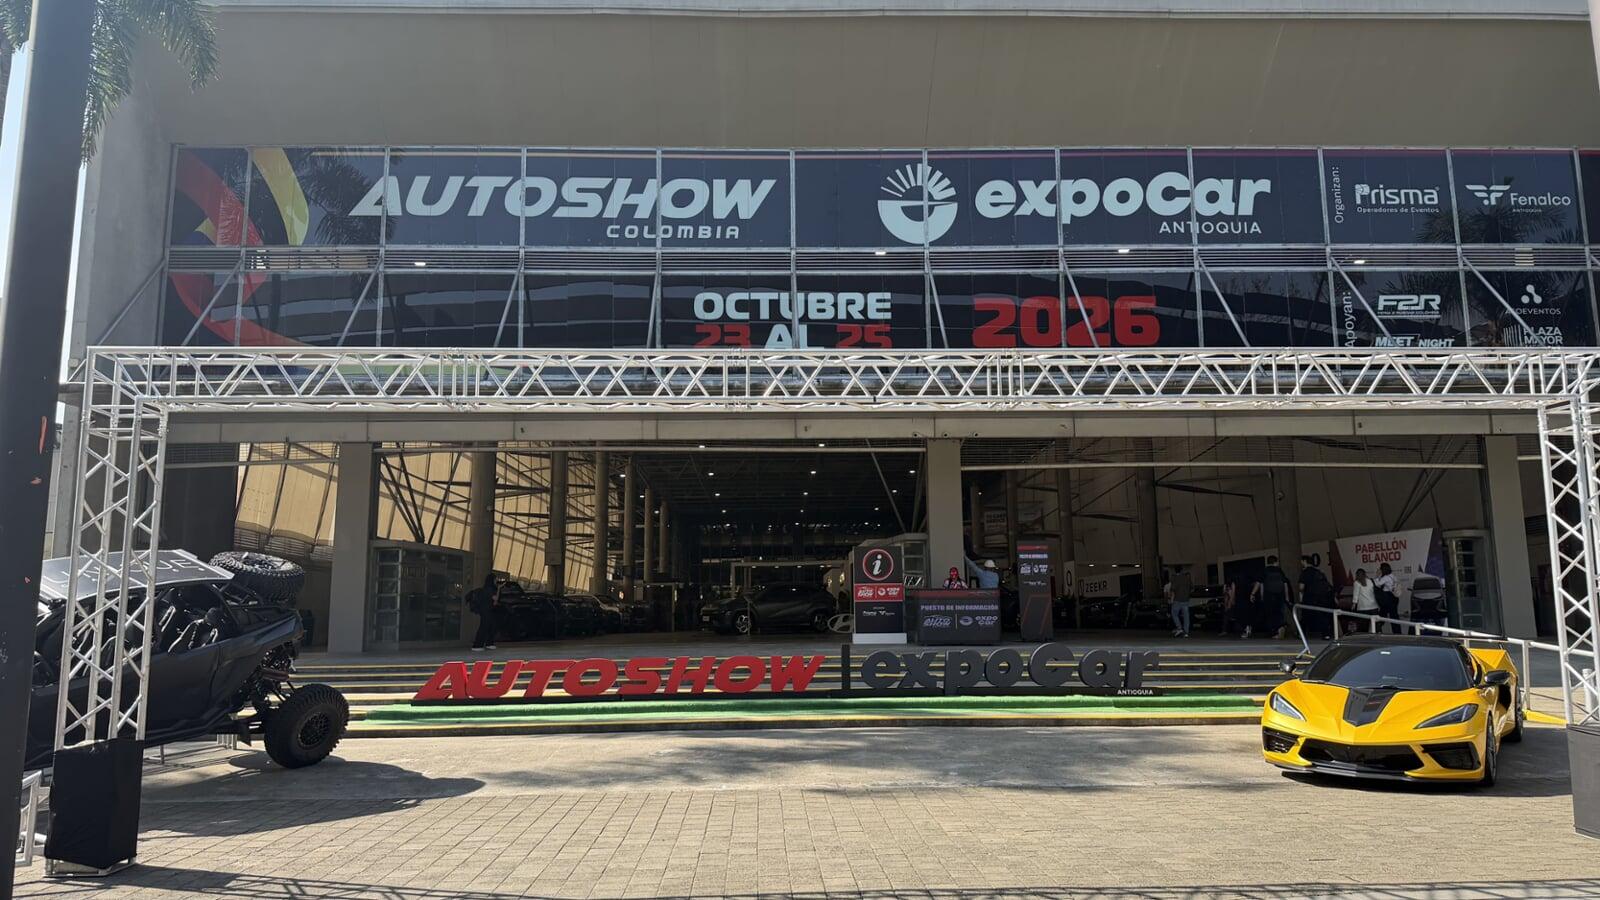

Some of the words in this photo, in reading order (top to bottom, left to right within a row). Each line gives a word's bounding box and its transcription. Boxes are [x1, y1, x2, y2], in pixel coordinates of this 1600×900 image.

[348, 175, 777, 220] AUTOSHOW
[974, 171, 1272, 224] expoCar
[1334, 166, 1345, 224] Organizan:
[1354, 183, 1440, 205] Prisma
[1510, 192, 1571, 206] Fenalco
[1356, 206, 1398, 214] Operadores
[606, 224, 740, 240] COLOMBIA
[1158, 220, 1263, 235] ANTIOQUIA
[693, 291, 892, 320] OCTUBRE
[1377, 294, 1441, 311] F2R
[972, 295, 1161, 347] 2026
[693, 323, 752, 348] 23
[764, 323, 825, 348] AL
[835, 323, 893, 348] 25
[1418, 338, 1455, 348] NIGHT
[1355, 537, 1408, 554] PABELLÓN
[1361, 550, 1402, 564] BLANCO
[1085, 580, 1108, 593] ZEEKR
[413, 654, 826, 699] AUTOSHOW
[860, 643, 1160, 696] expoCar
[1116, 688, 1154, 696] ANTIOQUIA
